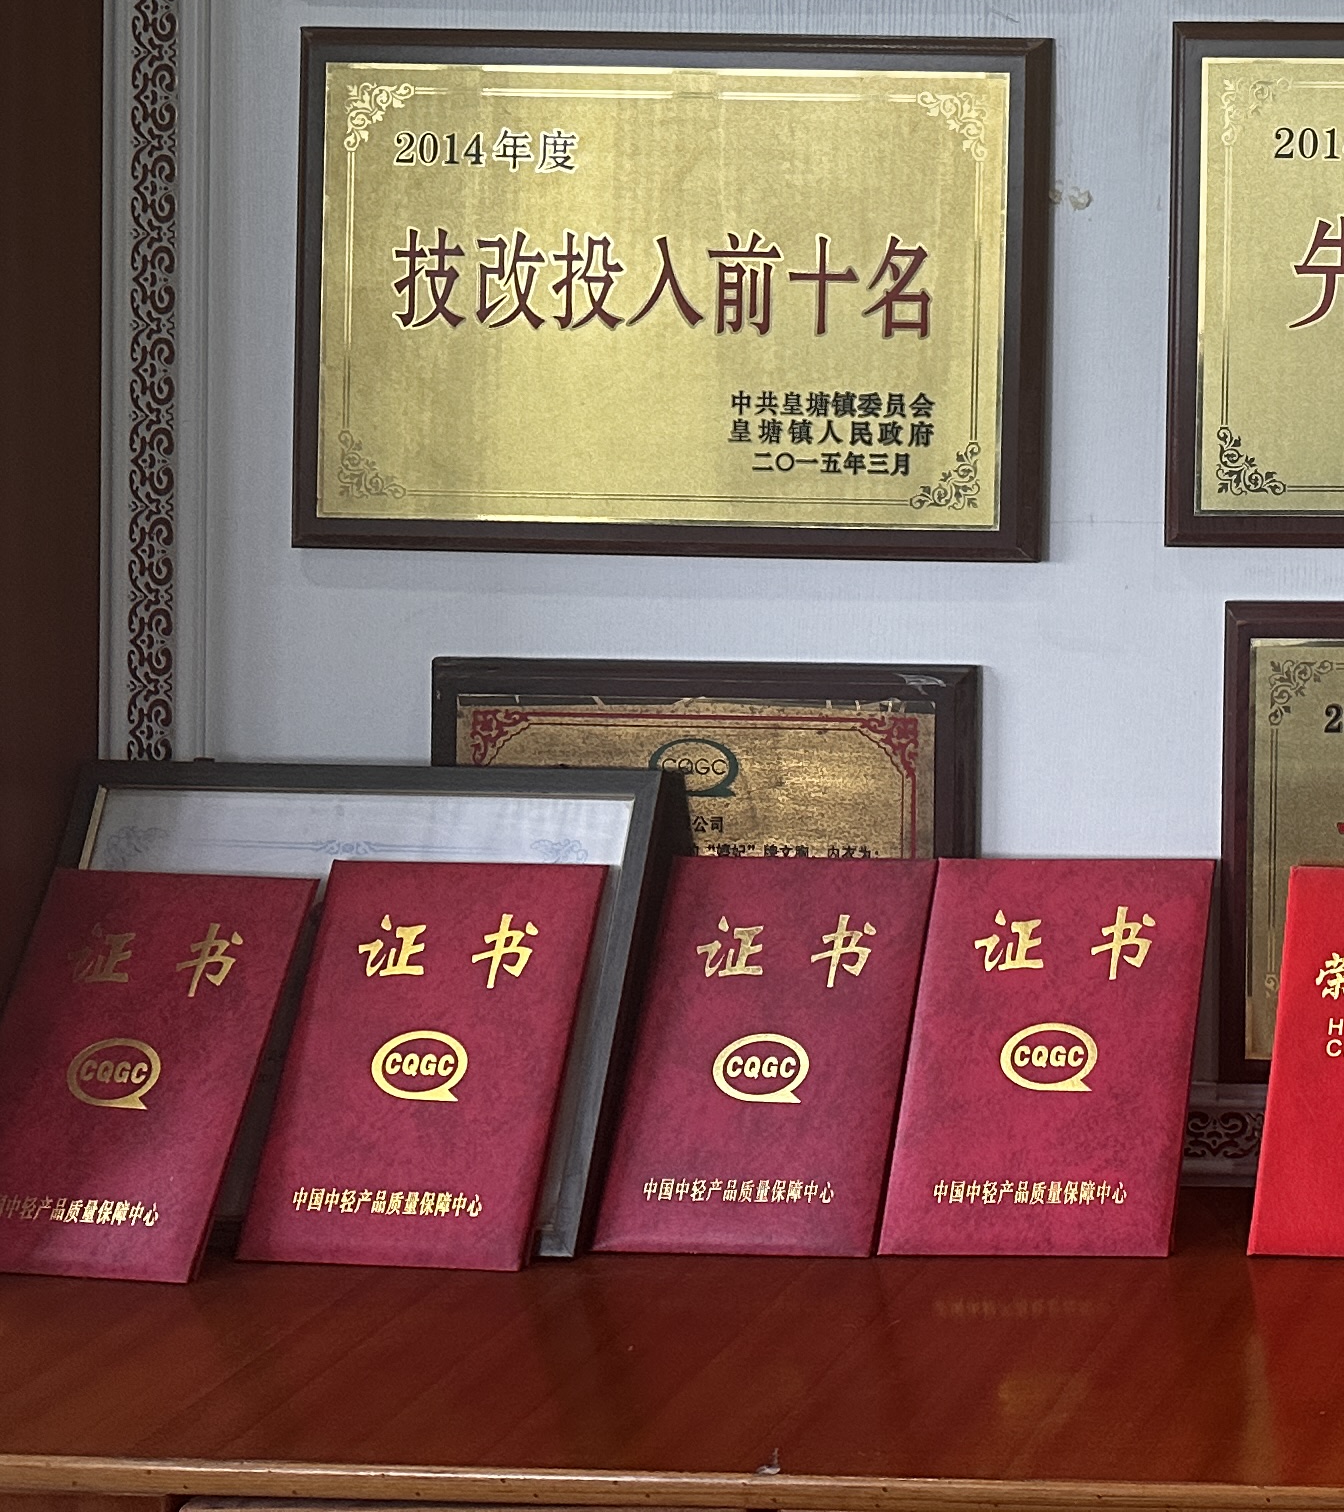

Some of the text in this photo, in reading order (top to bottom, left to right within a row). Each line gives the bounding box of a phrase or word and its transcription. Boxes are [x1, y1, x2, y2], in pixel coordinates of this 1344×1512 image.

[392, 226, 934, 341] 技改投入前十名
[730, 390, 936, 420] 中共皇塘镇委员会
[729, 419, 936, 448] 皇塘镇人民政府
[661, 758, 727, 775] CQGC
[356, 912, 540, 990] 证书
[696, 913, 877, 988] 证书
[973, 905, 1158, 981] 证书
[69, 921, 244, 999] 证书
[381, 1048, 459, 1080] CQGC
[723, 1051, 798, 1082] CQGC
[1011, 1042, 1087, 1069] CQGC
[78, 1057, 149, 1086] CQGC
[291, 1184, 486, 1219] 中国中轻产品质量保障中心
[641, 1175, 837, 1207] 中国中轻产品质量保障中心
[932, 1177, 1129, 1207] 中国中轻产品质量保障中心
[0, 1195, 159, 1226] 中轻产品质量保障中心
